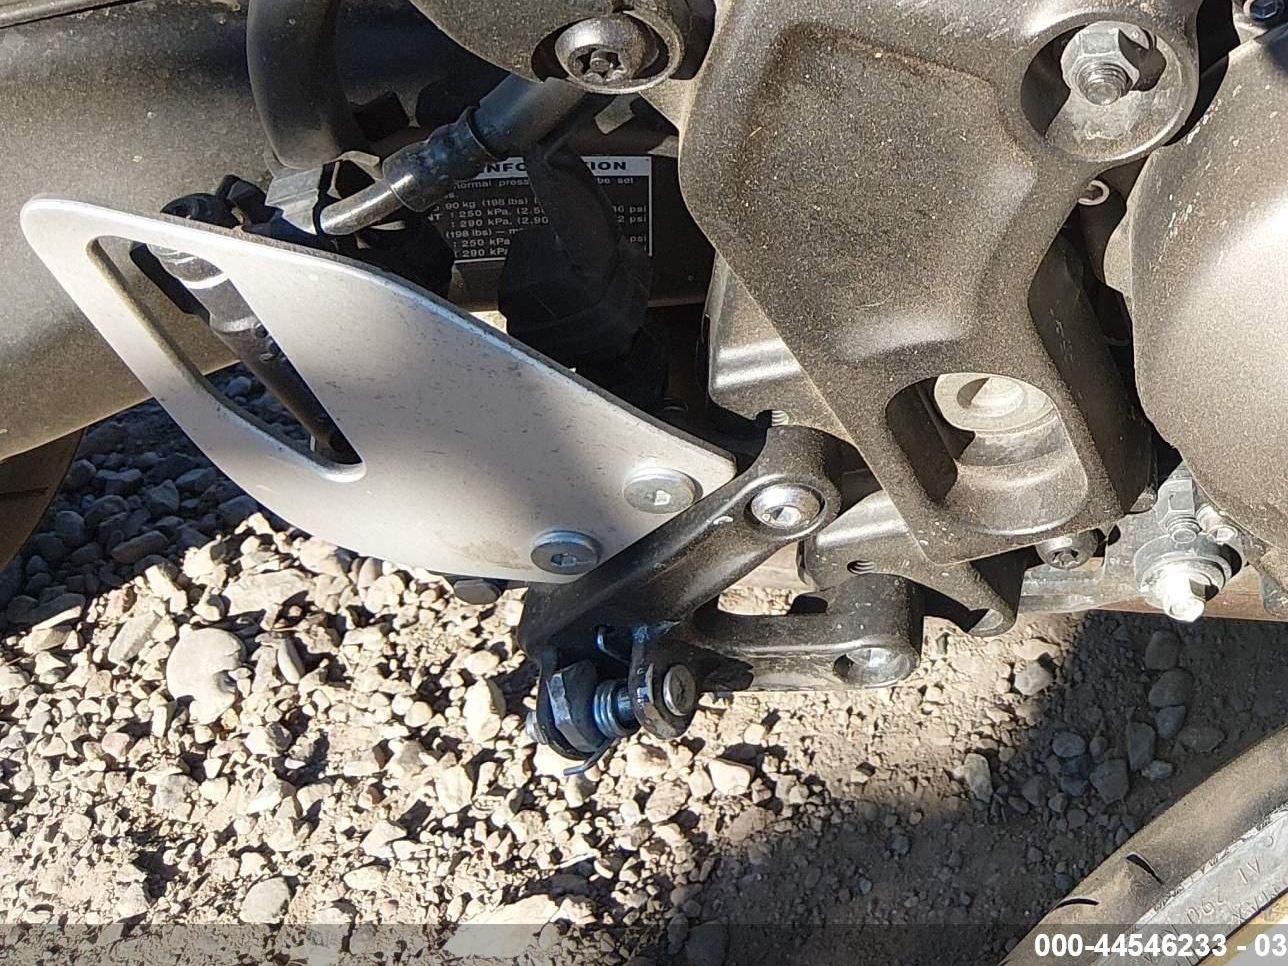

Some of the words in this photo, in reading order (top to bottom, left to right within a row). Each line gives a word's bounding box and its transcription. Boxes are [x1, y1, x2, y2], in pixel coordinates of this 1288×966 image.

[462, 201, 476, 210] kg
[459, 209, 482, 218] 250
[630, 204, 647, 214] psi
[460, 219, 483, 228] 290
[630, 215, 647, 224] psi
[472, 228, 493, 237] lbs)
[462, 239, 485, 248] 250
[462, 249, 485, 259] 290
